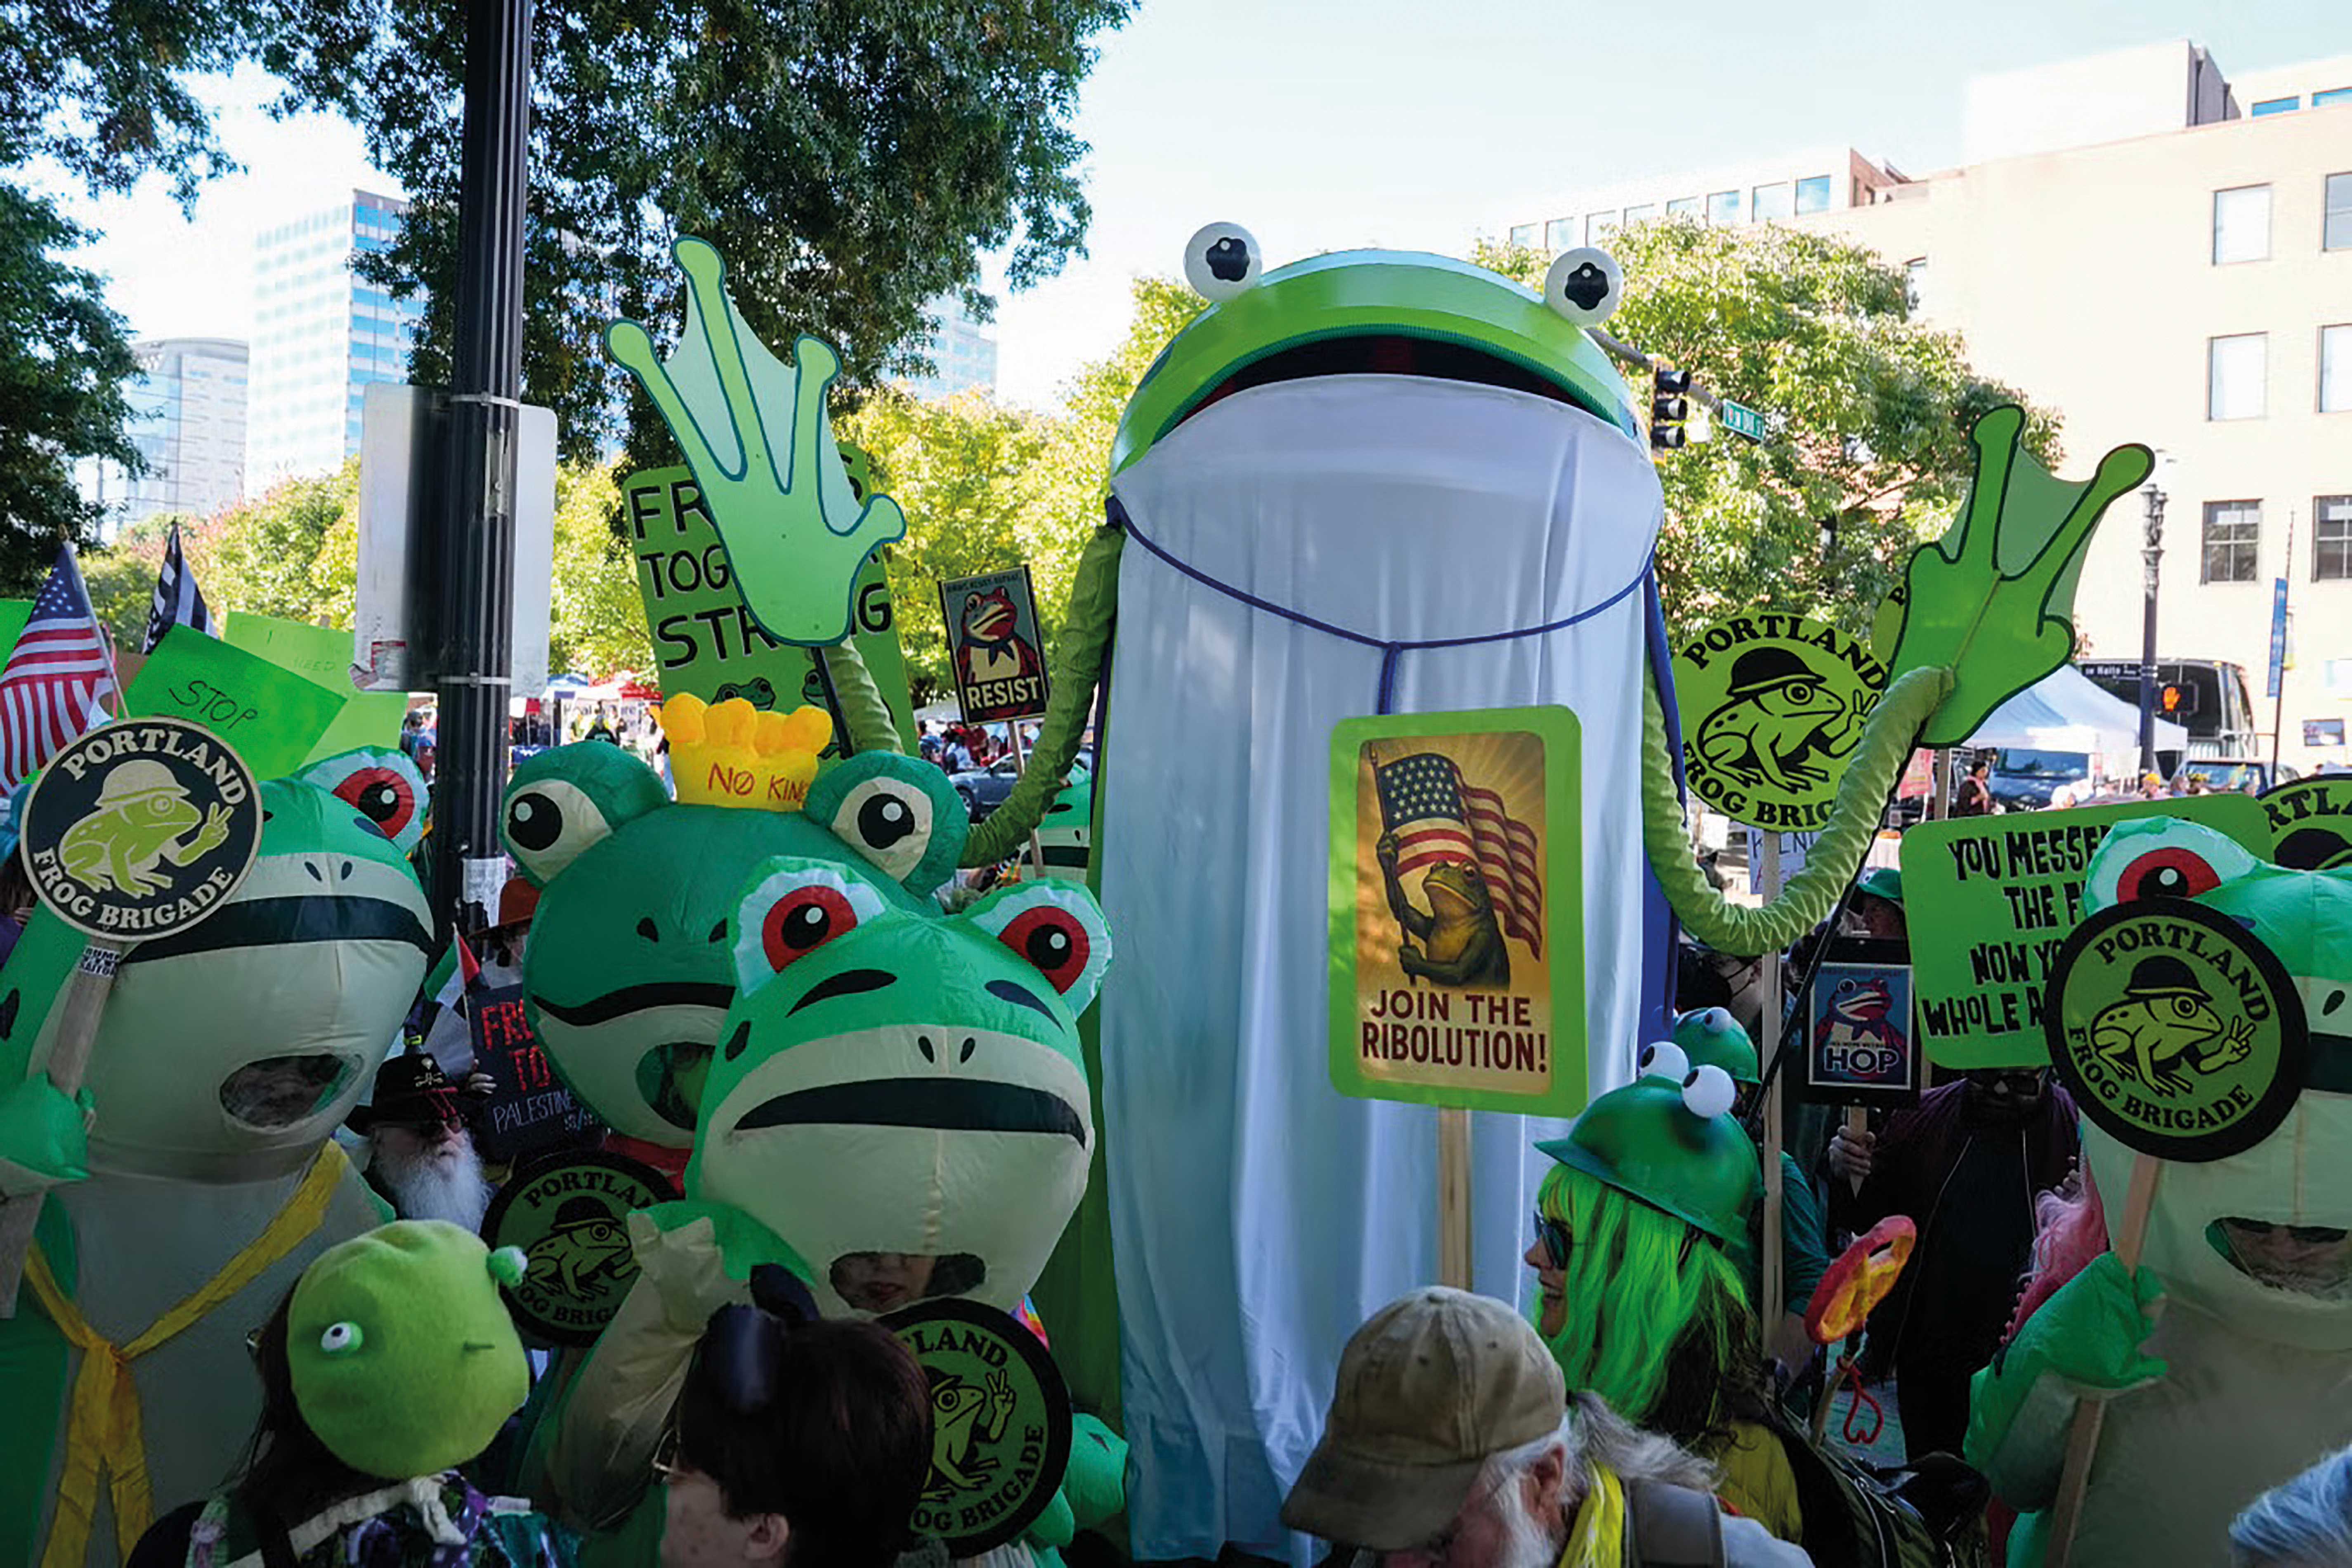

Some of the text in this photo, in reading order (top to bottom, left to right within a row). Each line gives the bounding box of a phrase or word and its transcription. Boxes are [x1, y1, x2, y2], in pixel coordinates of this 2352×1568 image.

[1682, 615, 1886, 690] PORTLAND
[169, 680, 258, 730] STOP
[966, 676, 1039, 710] RESIST
[61, 729, 246, 805] PORTLAND
[1948, 836, 2001, 881] YOU
[33, 846, 234, 929] FROG BRIGADE
[2004, 884, 2058, 930] THE
[1969, 941, 2031, 985] NOW
[2095, 923, 2269, 1022] PORTLAND
[1371, 989, 1533, 1027] JOIN THE
[1922, 991, 2021, 1037] WHOLE
[509, 1045, 551, 1093] TO
[1363, 1021, 1547, 1073] RIBOLUTION!
[1824, 1046, 1899, 1073] HOP
[2068, 1027, 2254, 1129] FROG BRIGADE
[520, 1286, 612, 1323] OG BRIG
[912, 1327, 1008, 1367] LAND
[913, 1424, 1044, 1528] OG BRIGADE
